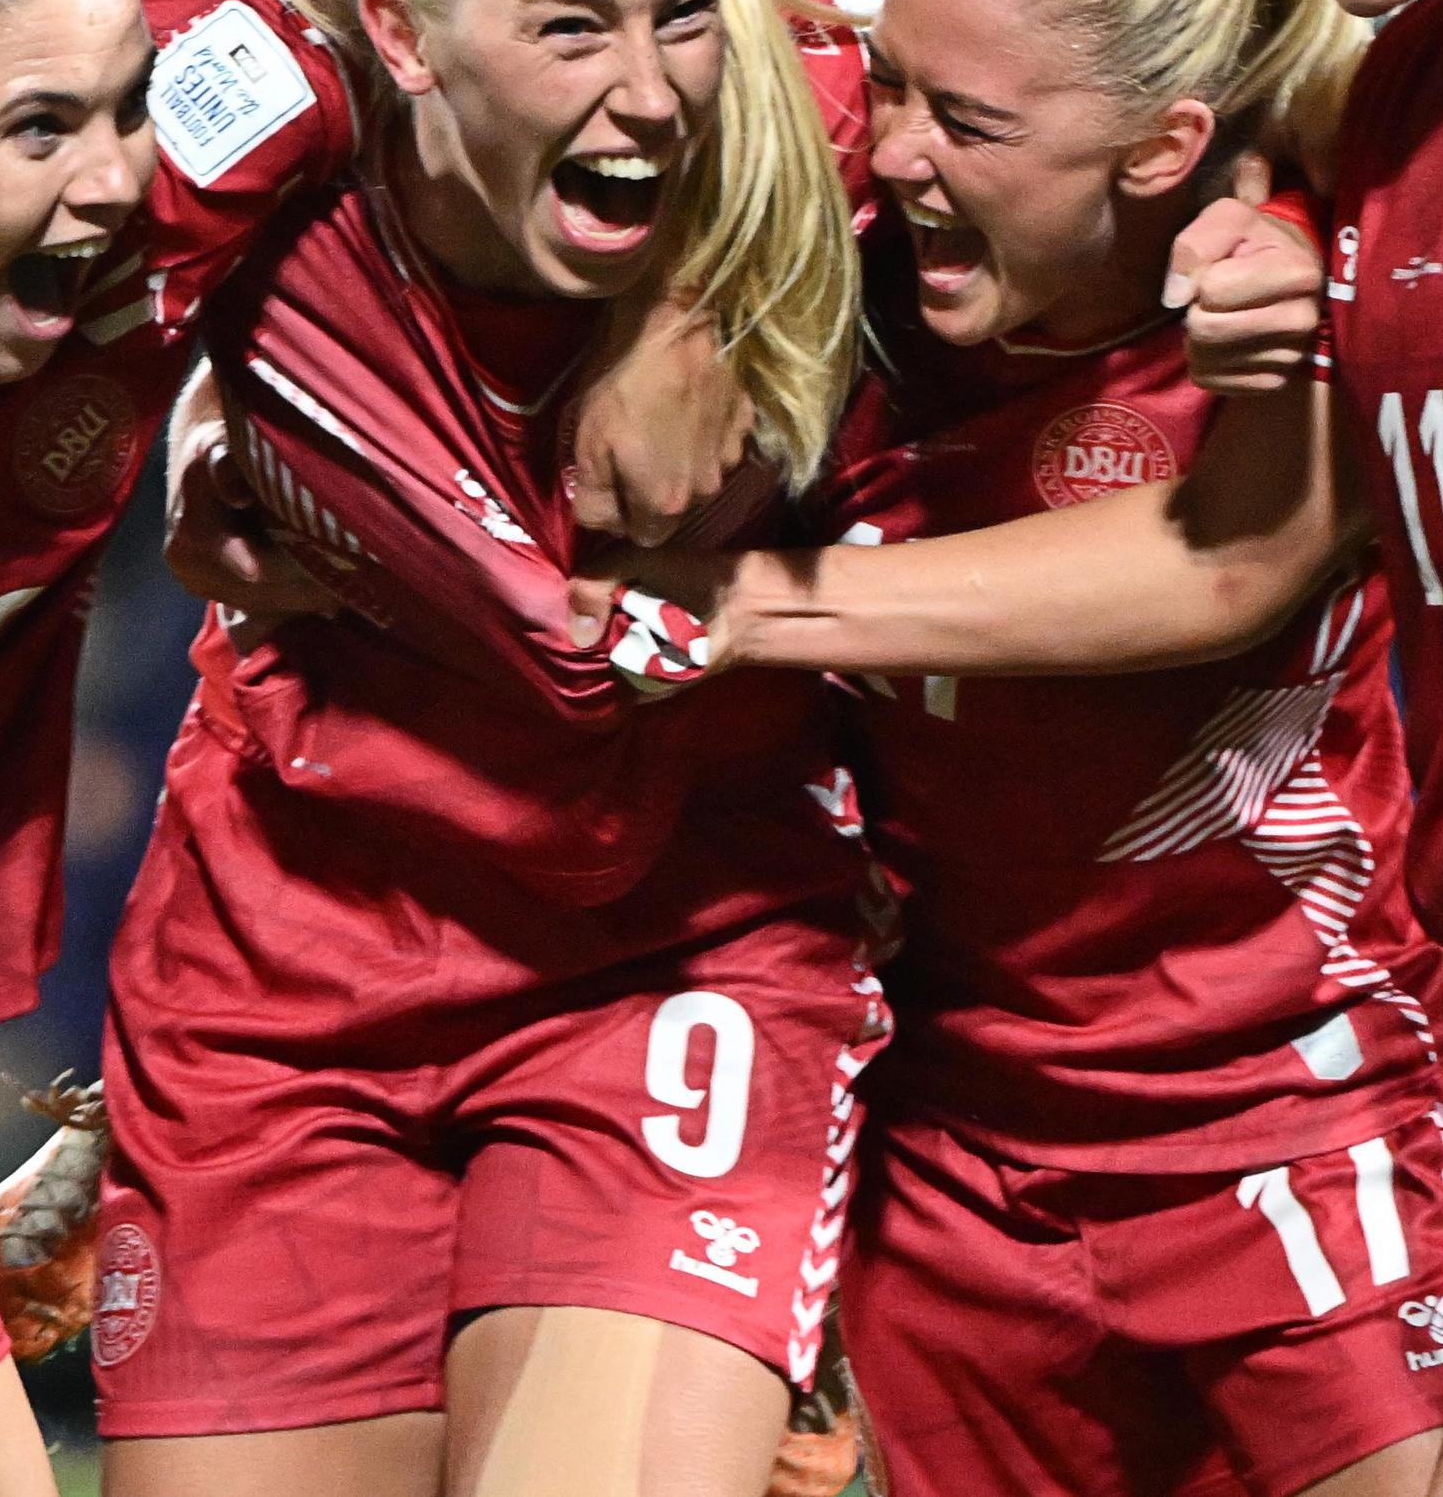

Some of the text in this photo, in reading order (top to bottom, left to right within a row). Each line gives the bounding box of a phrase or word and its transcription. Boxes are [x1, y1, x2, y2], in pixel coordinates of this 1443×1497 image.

[175, 64, 238, 134] UNITES
[192, 44, 239, 94] World
[160, 83, 214, 148] FOOTBALL
[42, 404, 110, 482] DBU
[1064, 445, 1145, 483] DBU
[641, 990, 756, 1178] 9
